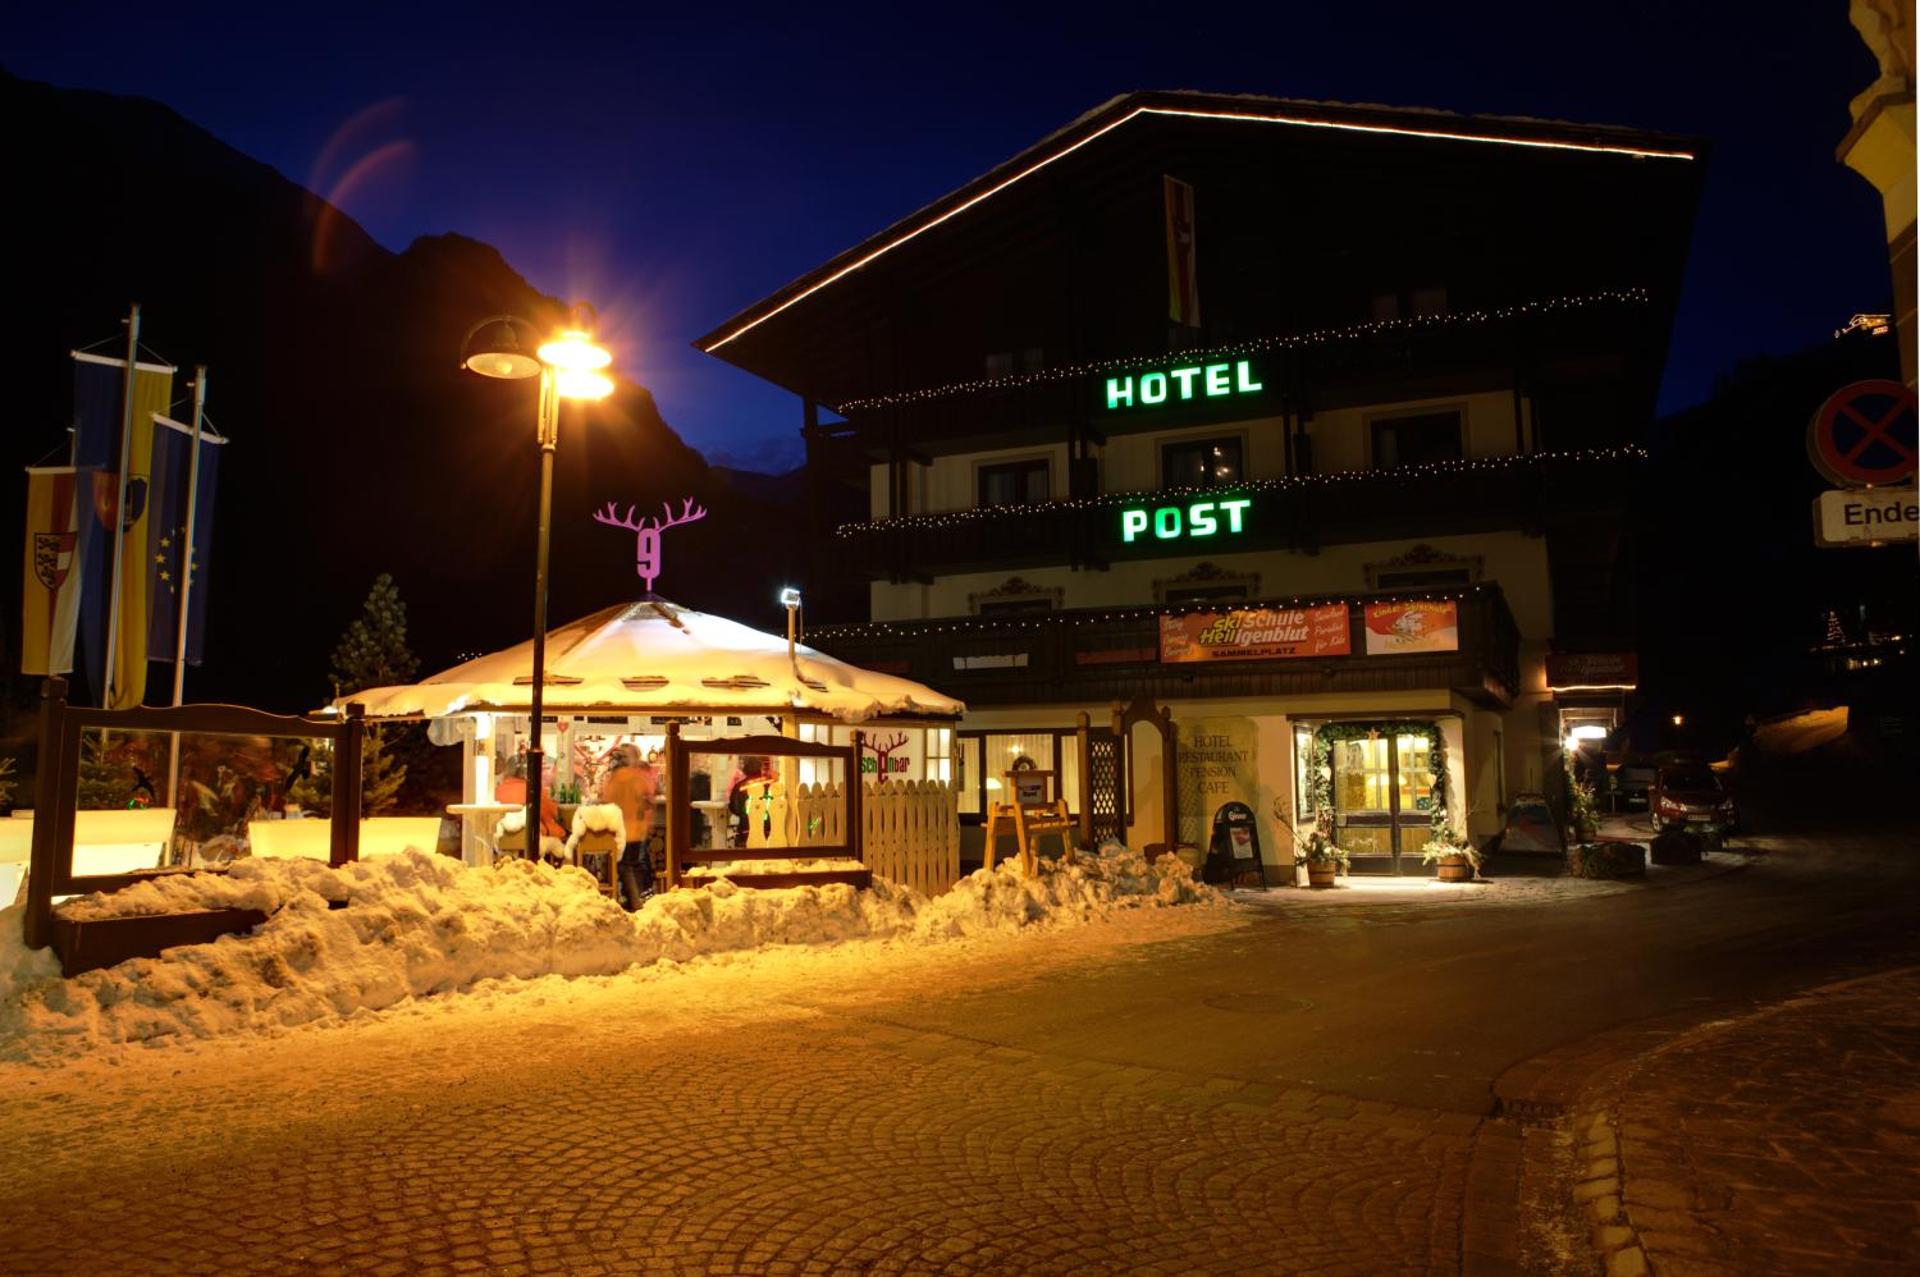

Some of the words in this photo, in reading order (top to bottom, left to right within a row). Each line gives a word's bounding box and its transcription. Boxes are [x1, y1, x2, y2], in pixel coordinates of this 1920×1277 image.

[1106, 360, 1263, 409] HOTEL
[1122, 500, 1251, 543] POST
[1844, 501, 1919, 525] Ende
[1200, 625, 1310, 647] Heiligenblut
[1193, 735, 1232, 748] HOTEL
[1178, 751, 1249, 764] RESTAURANT
